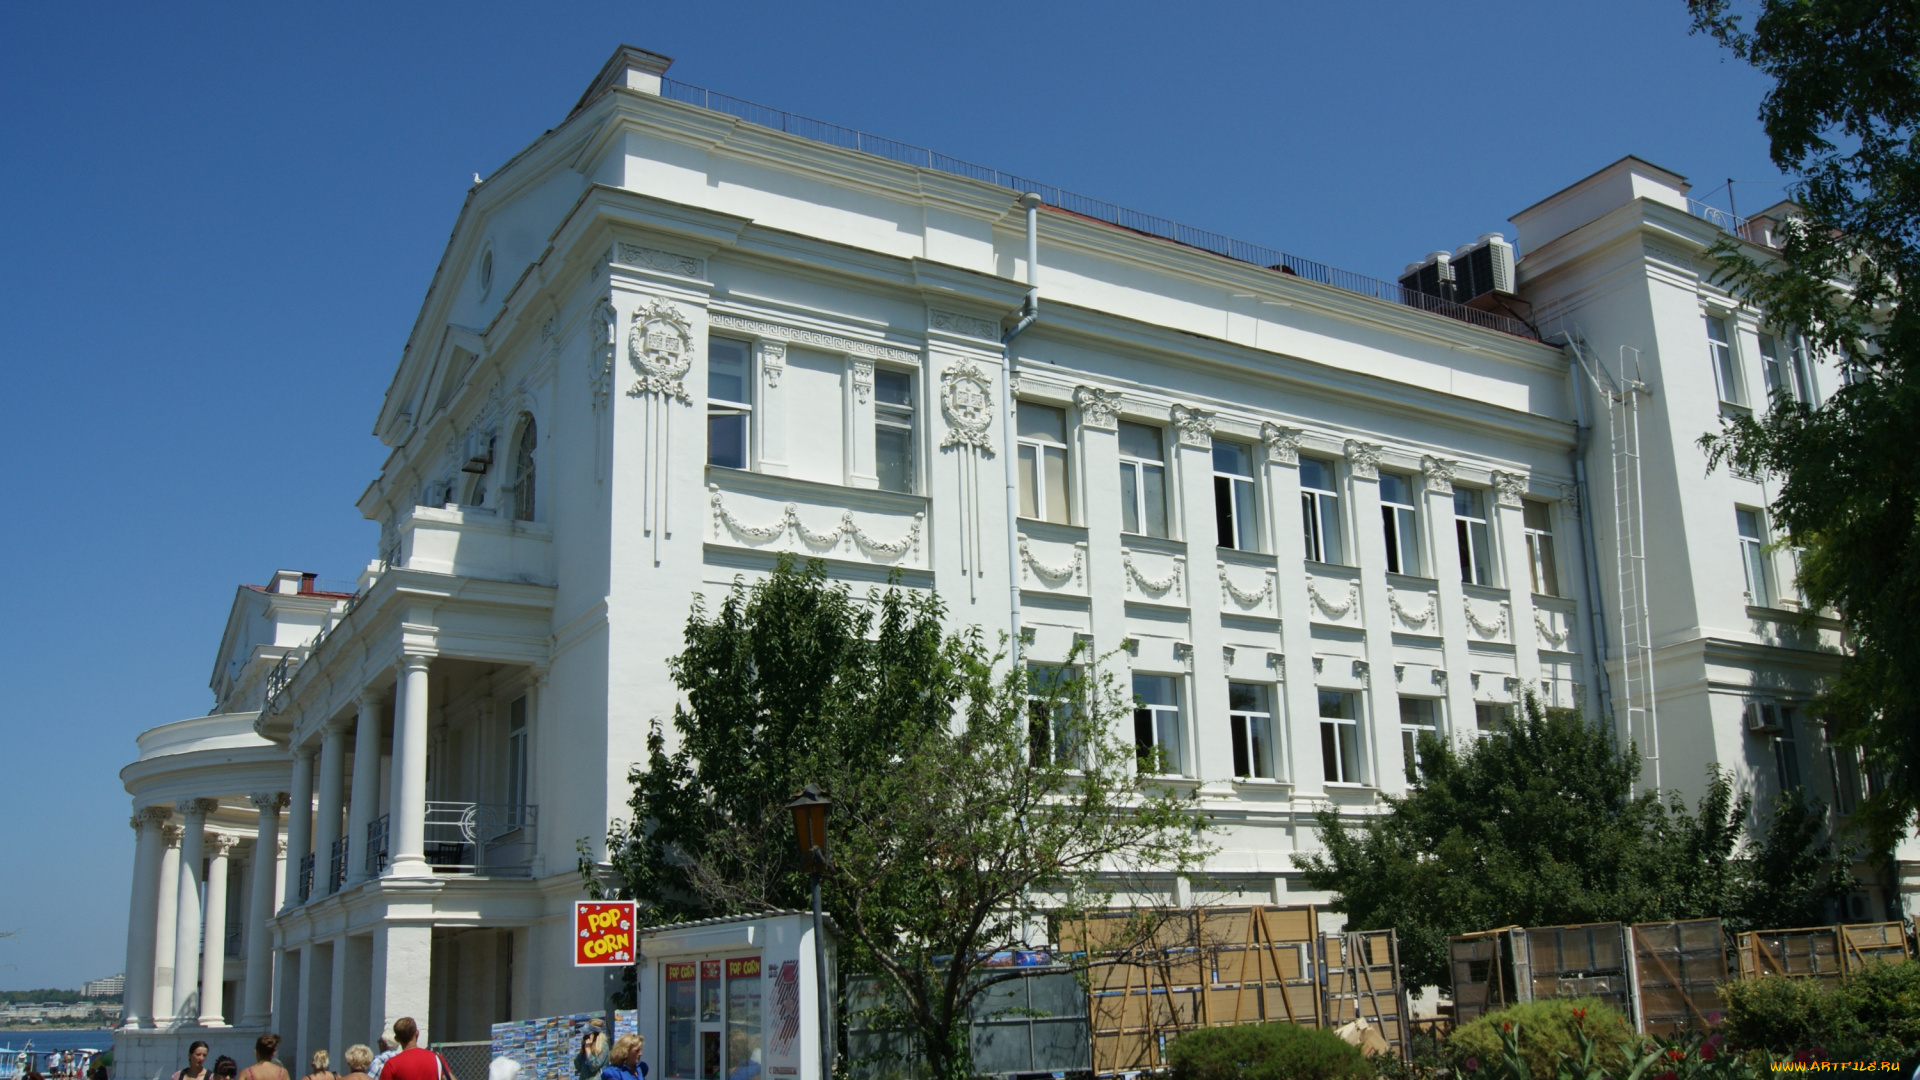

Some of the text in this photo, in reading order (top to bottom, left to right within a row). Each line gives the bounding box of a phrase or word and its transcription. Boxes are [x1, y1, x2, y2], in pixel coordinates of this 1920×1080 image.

[589, 909, 621, 933] POP
[584, 933, 629, 958] CORN
[669, 964, 694, 980] POP CORN
[729, 961, 742, 976] POP
[743, 959, 760, 975] CORN
